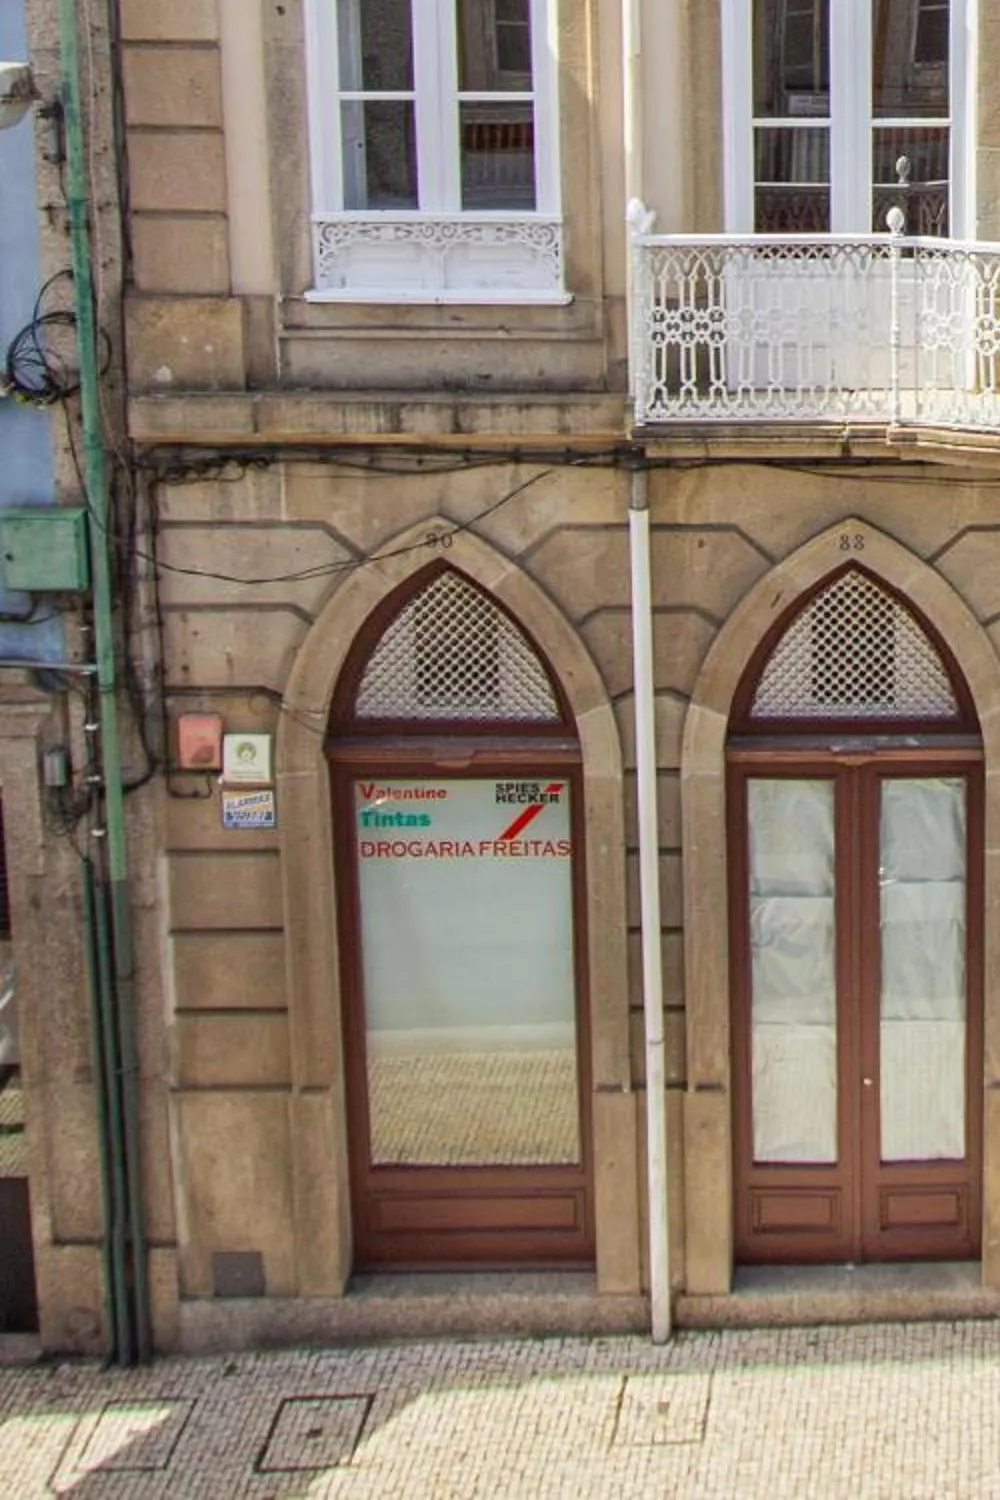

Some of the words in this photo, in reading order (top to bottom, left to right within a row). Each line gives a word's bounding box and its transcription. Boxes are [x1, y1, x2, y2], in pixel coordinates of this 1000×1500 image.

[840, 533, 865, 551] 88
[361, 782, 448, 799] Valentine
[495, 782, 541, 793] SPIES
[495, 793, 561, 804] HECKER
[360, 811, 432, 828] Tintas
[360, 841, 476, 858] DROGARIA
[479, 840, 572, 857] FREITAS
